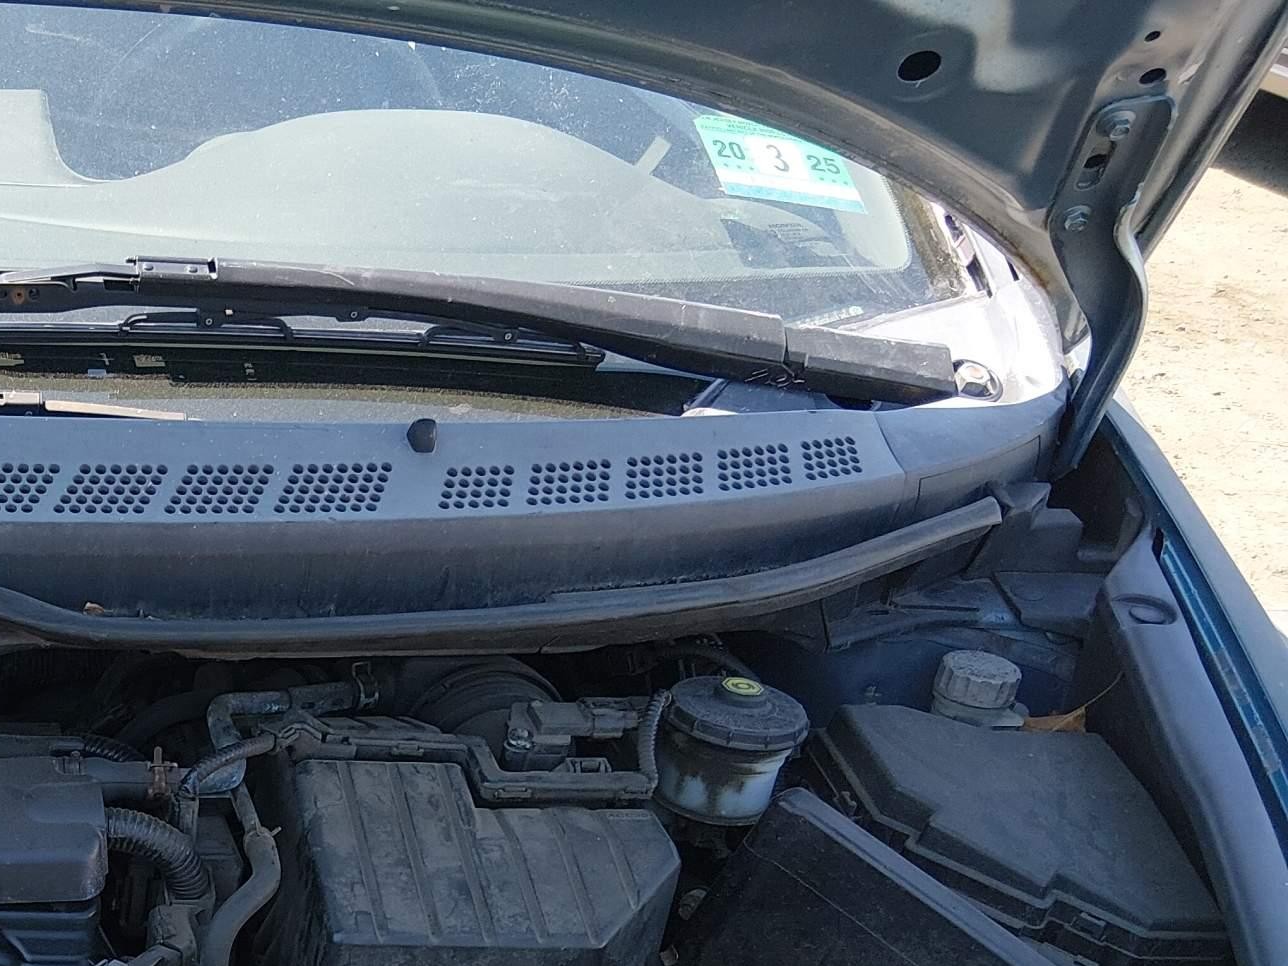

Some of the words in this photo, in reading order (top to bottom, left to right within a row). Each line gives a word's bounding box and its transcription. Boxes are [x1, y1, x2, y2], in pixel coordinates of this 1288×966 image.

[712, 139, 746, 160] 20
[765, 144, 790, 172] 3
[806, 154, 841, 174] 25
